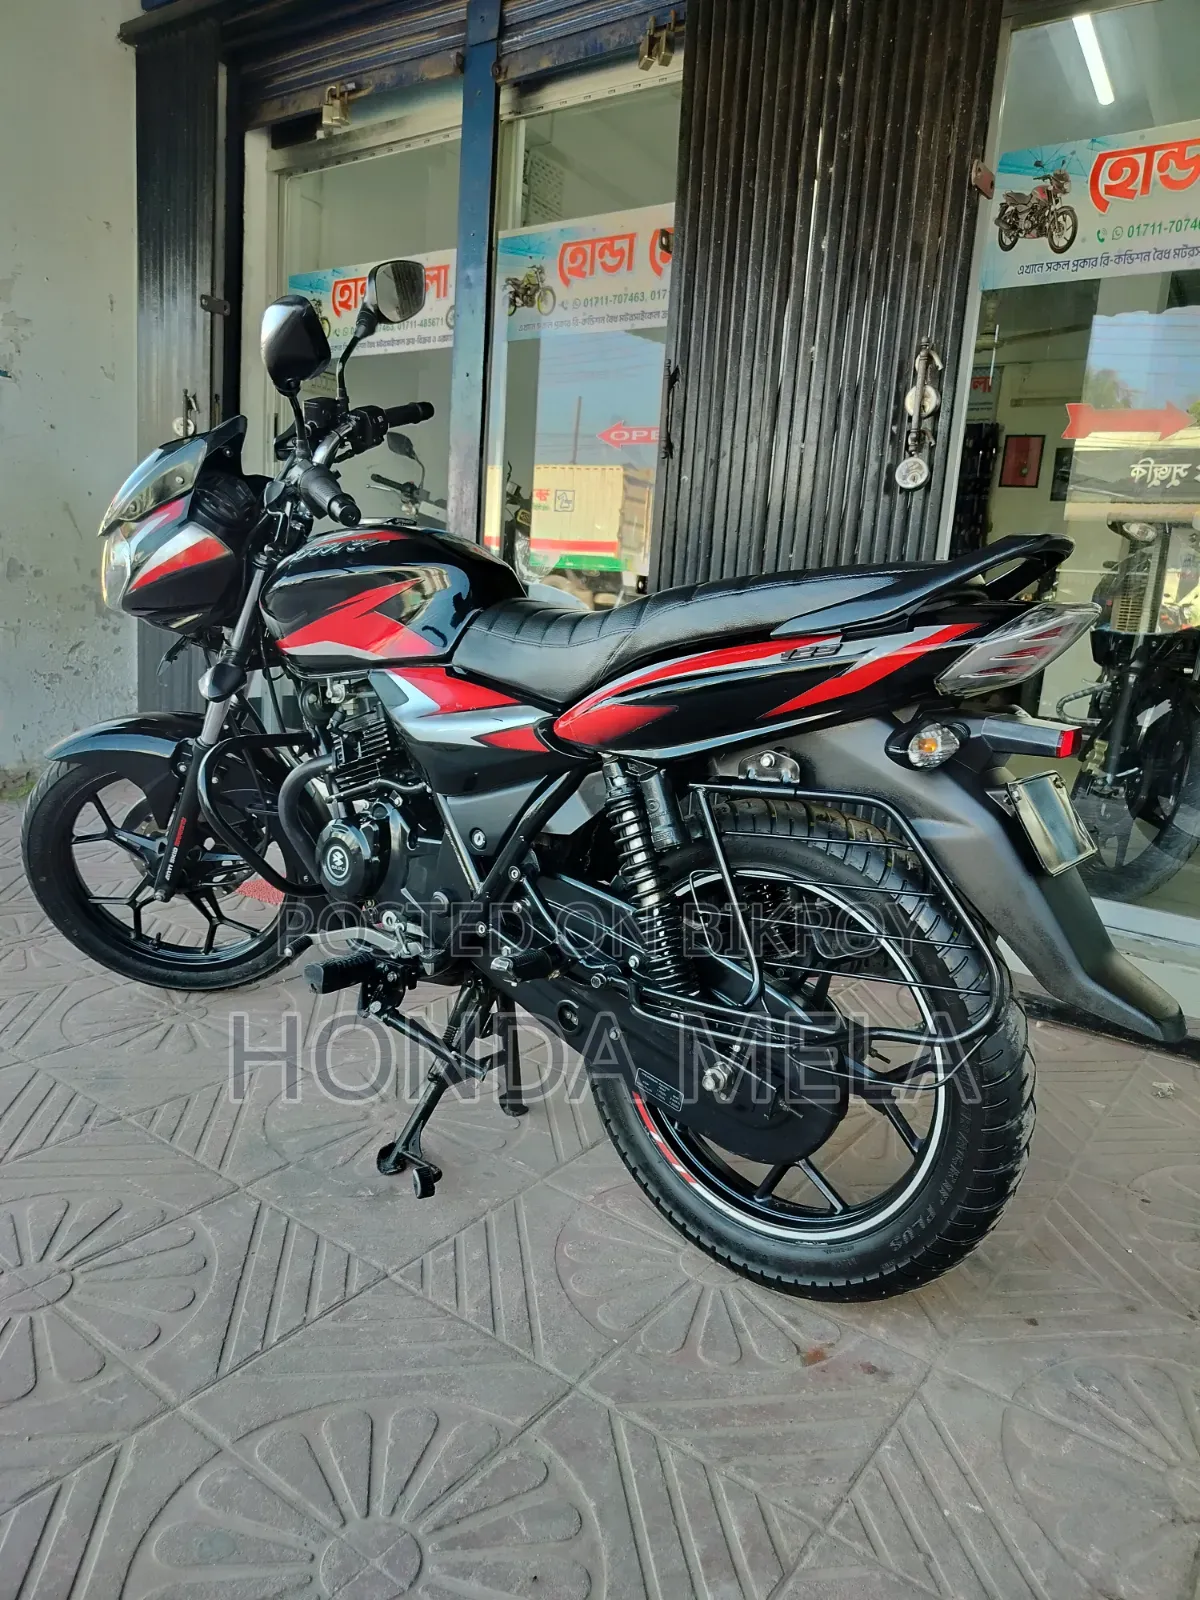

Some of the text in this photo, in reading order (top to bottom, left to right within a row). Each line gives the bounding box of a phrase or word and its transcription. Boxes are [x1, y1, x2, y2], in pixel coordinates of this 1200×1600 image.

[1127, 216, 1200, 238] 01711-7074
[557, 232, 638, 288] হোন্ডা
[1017, 262, 1044, 275] এখানে
[1046, 260, 1070, 272] সকল
[650, 289, 668, 301] 017
[889, 1203, 937, 1251] PLUS
